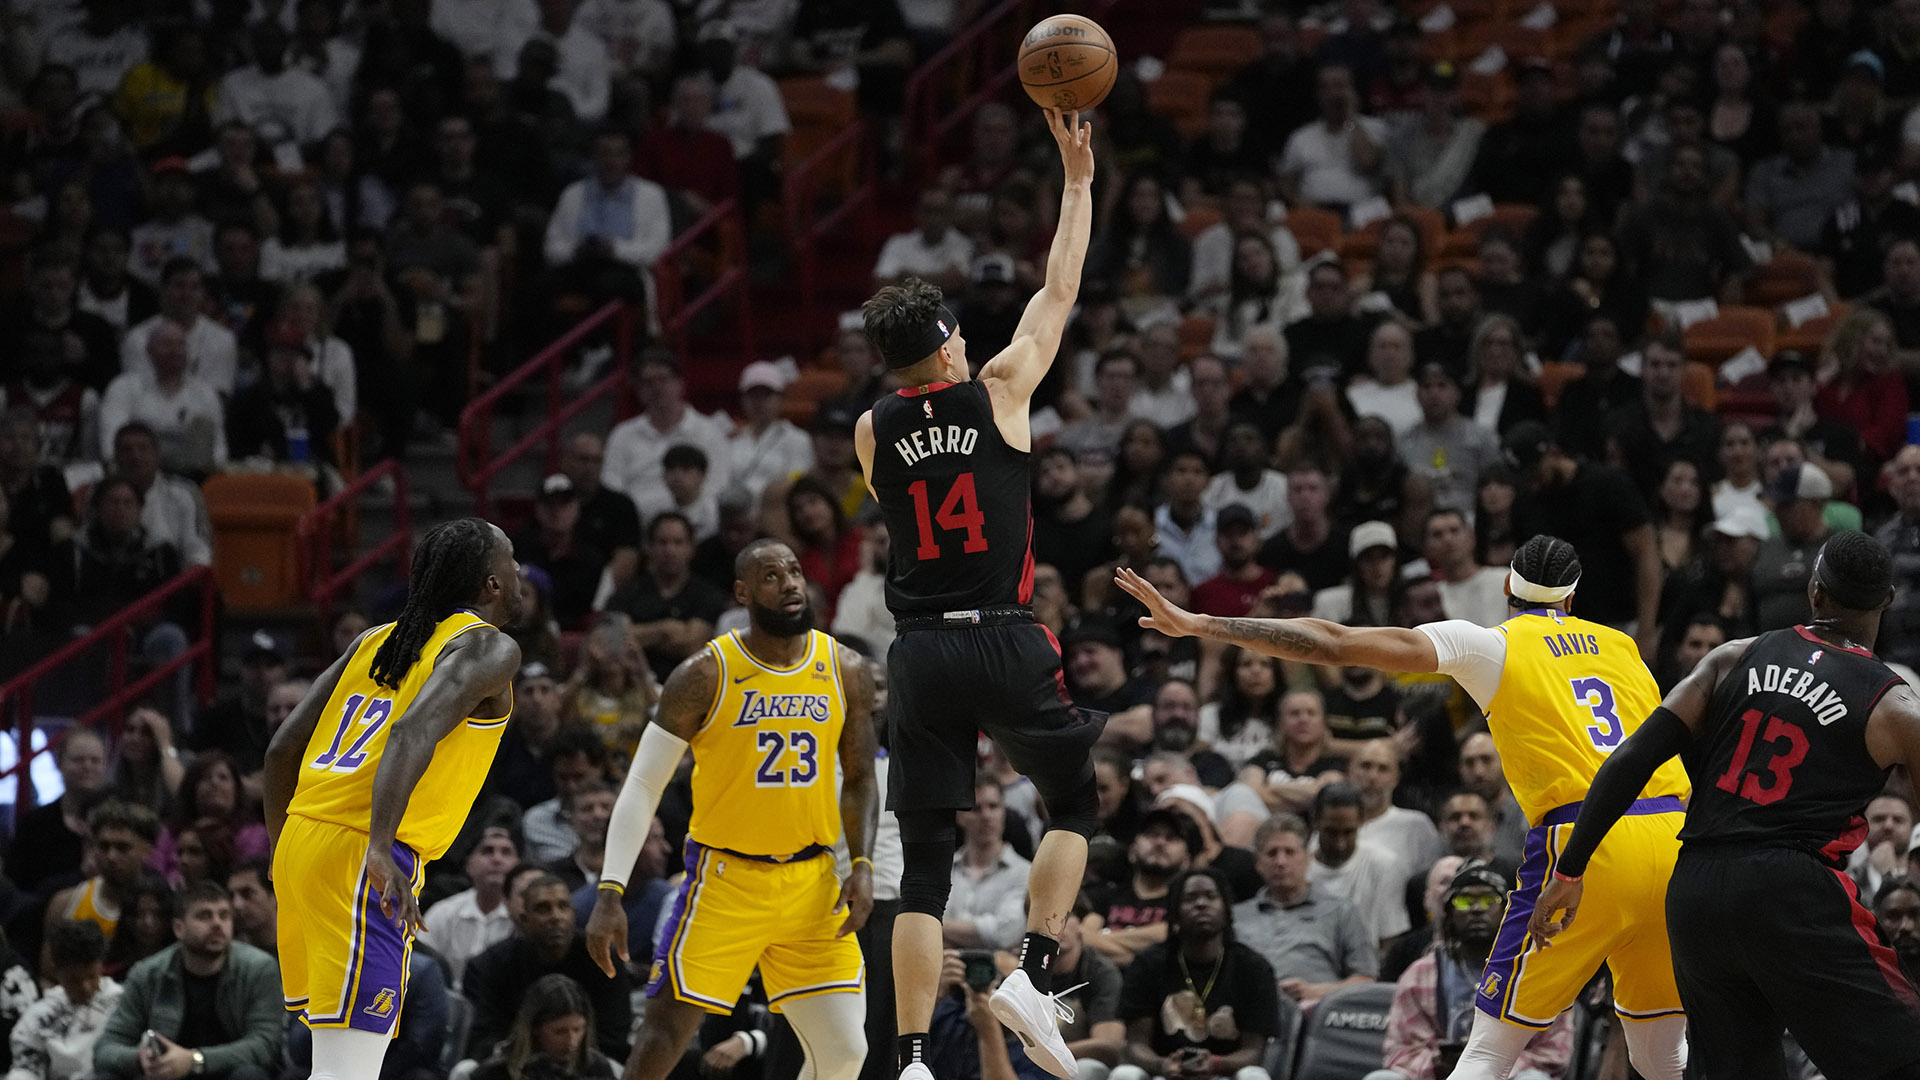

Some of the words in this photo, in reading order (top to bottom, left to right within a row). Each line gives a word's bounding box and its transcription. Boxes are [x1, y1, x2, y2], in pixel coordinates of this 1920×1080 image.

[1024, 23, 1087, 48] Wilson
[894, 425, 979, 467] HERRO
[907, 472, 989, 560] 14
[1543, 633, 1600, 658] DAVIS
[731, 688, 831, 728] LAKERS
[1568, 675, 1627, 753] 3
[1747, 664, 1848, 726] ADEBAYO
[309, 692, 394, 774] 12
[755, 729, 819, 788] 23
[1715, 708, 1811, 806] 13
